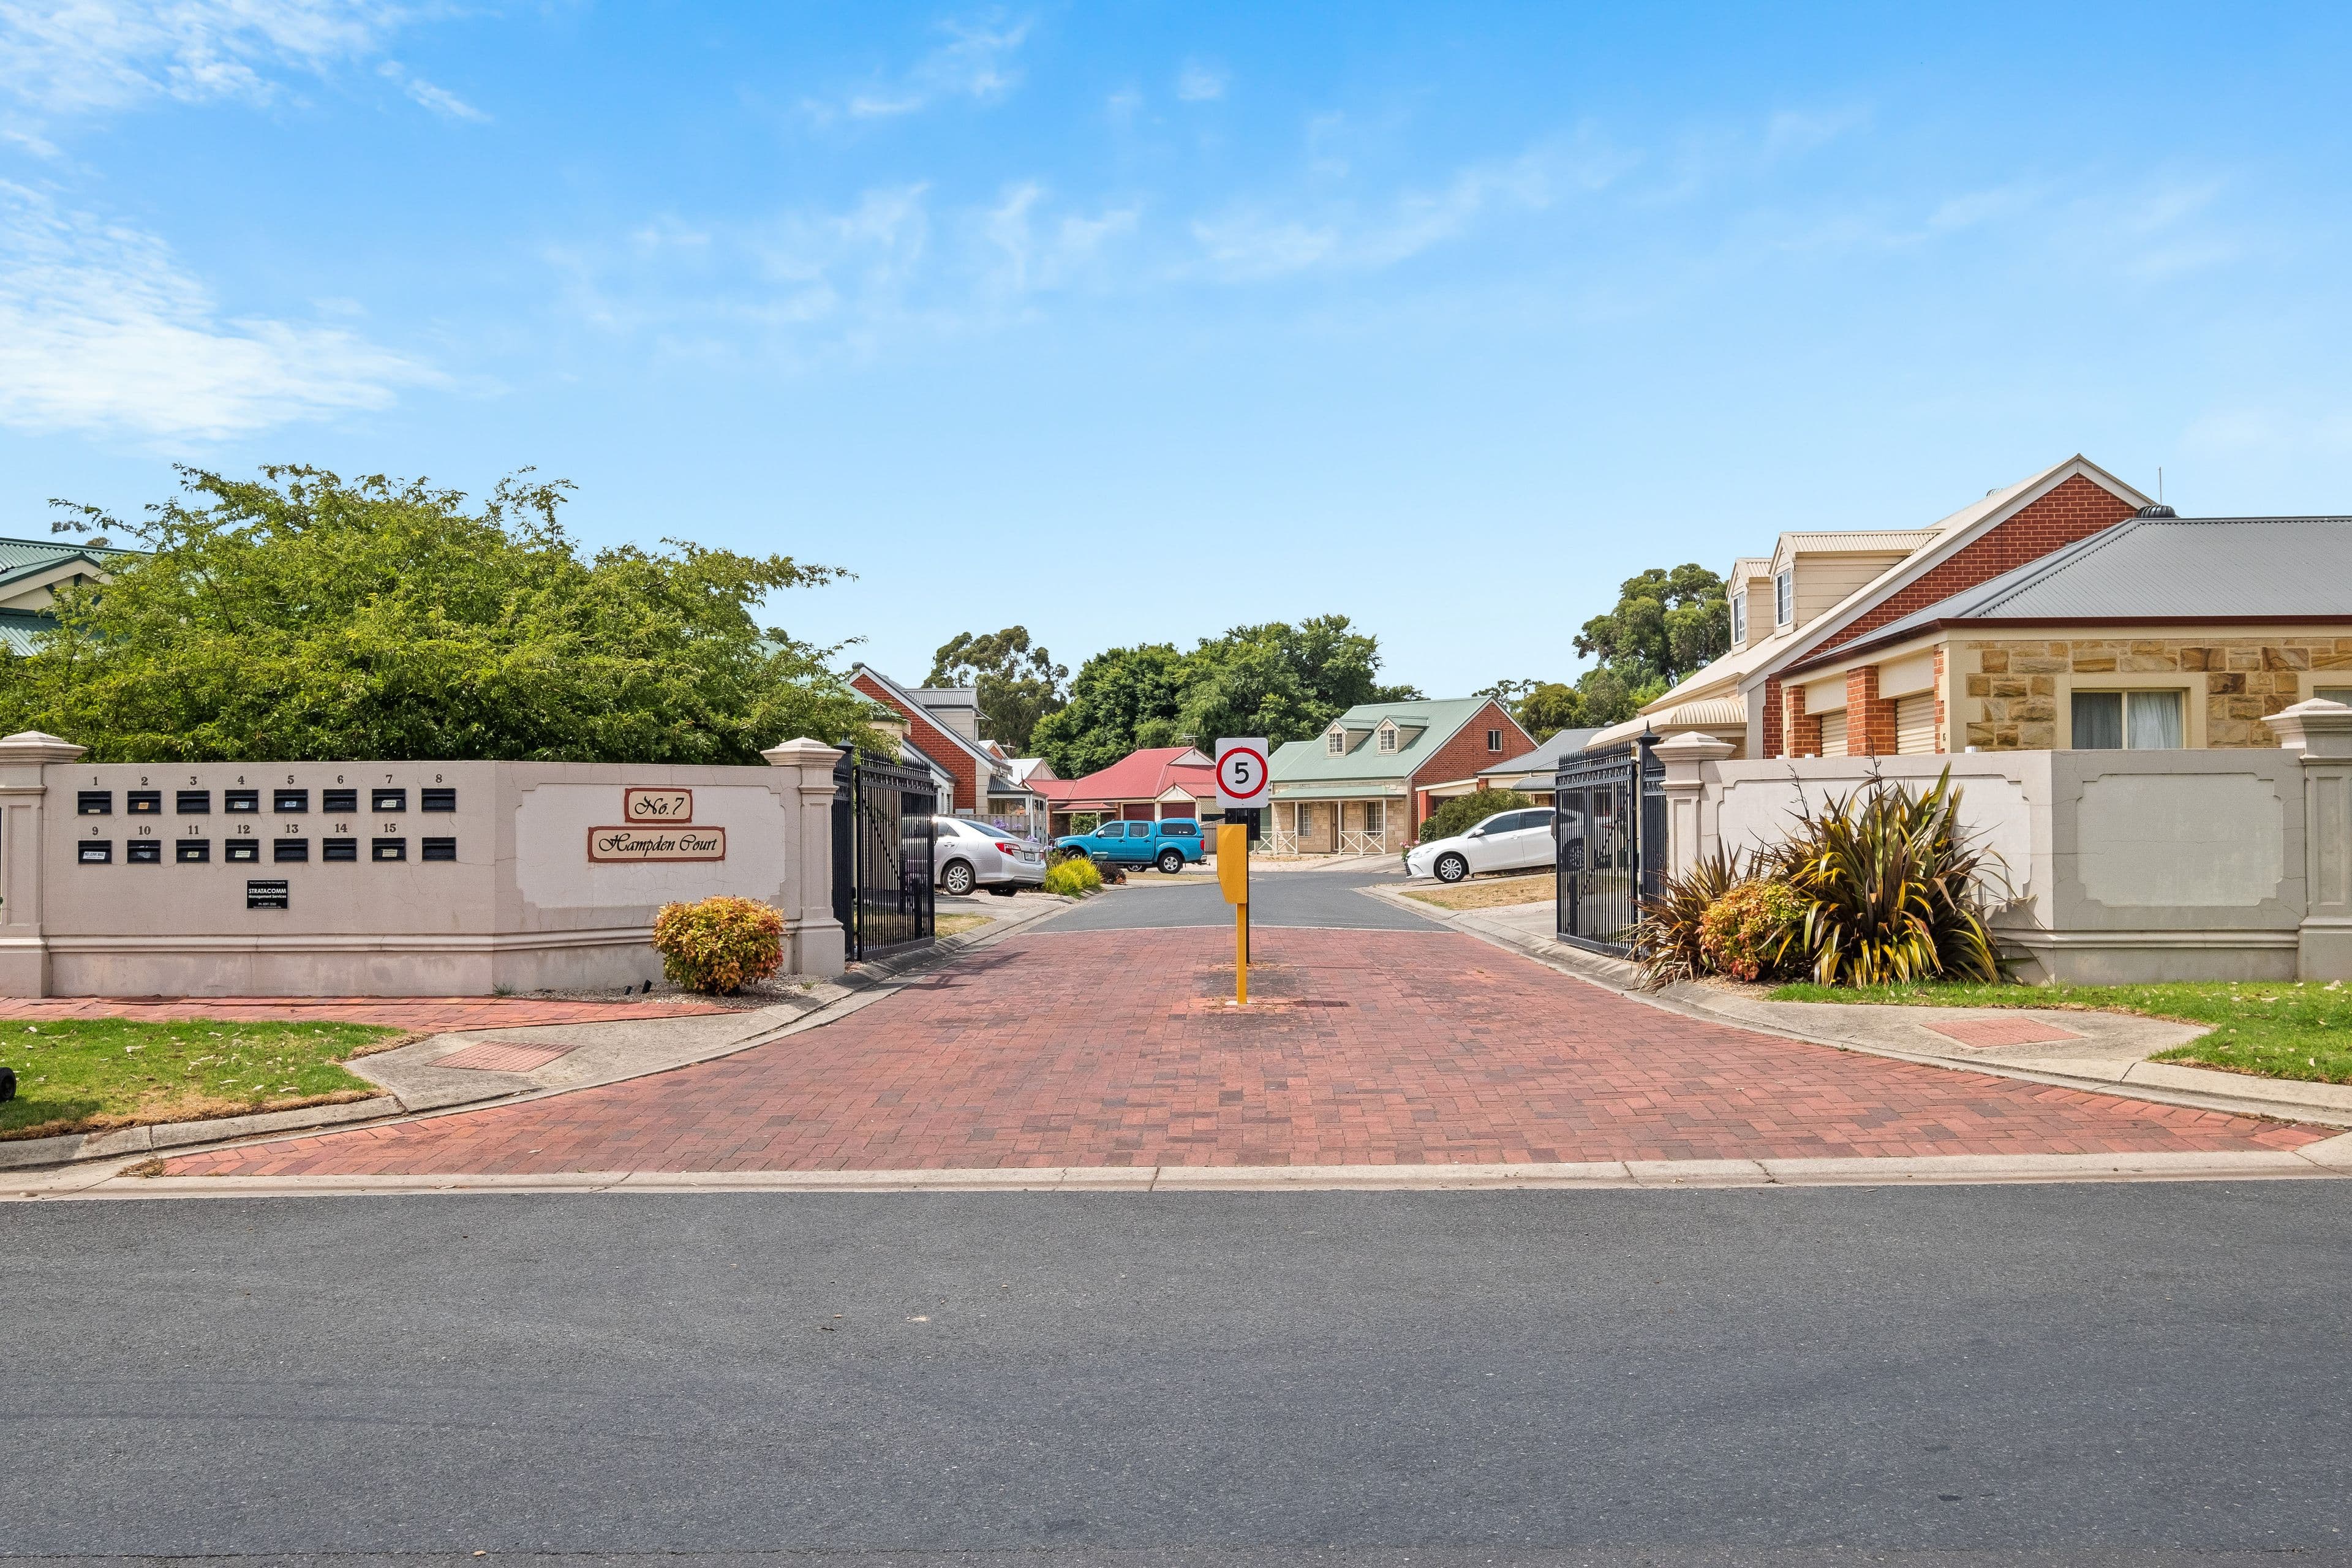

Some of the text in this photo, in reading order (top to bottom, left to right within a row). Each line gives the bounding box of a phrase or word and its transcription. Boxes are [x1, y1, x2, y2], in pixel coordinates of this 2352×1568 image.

[435, 774, 443, 783] 8
[1234, 762, 1250, 785] 5
[93, 776, 98, 786] 1
[141, 776, 148, 786] 2
[190, 776, 197, 786] 3
[237, 775, 245, 785] 4
[287, 775, 295, 785] 5
[337, 775, 344, 784] 6
[385, 774, 393, 784] 7
[635, 796, 685, 815] No. 7
[92, 826, 99, 836] 9
[138, 826, 151, 835] 10
[188, 825, 199, 835] 11
[237, 824, 251, 834] 12
[286, 824, 299, 834] 13
[335, 823, 348, 833] 14
[383, 823, 396, 833] 15
[598, 833, 718, 858] Hampden Court
